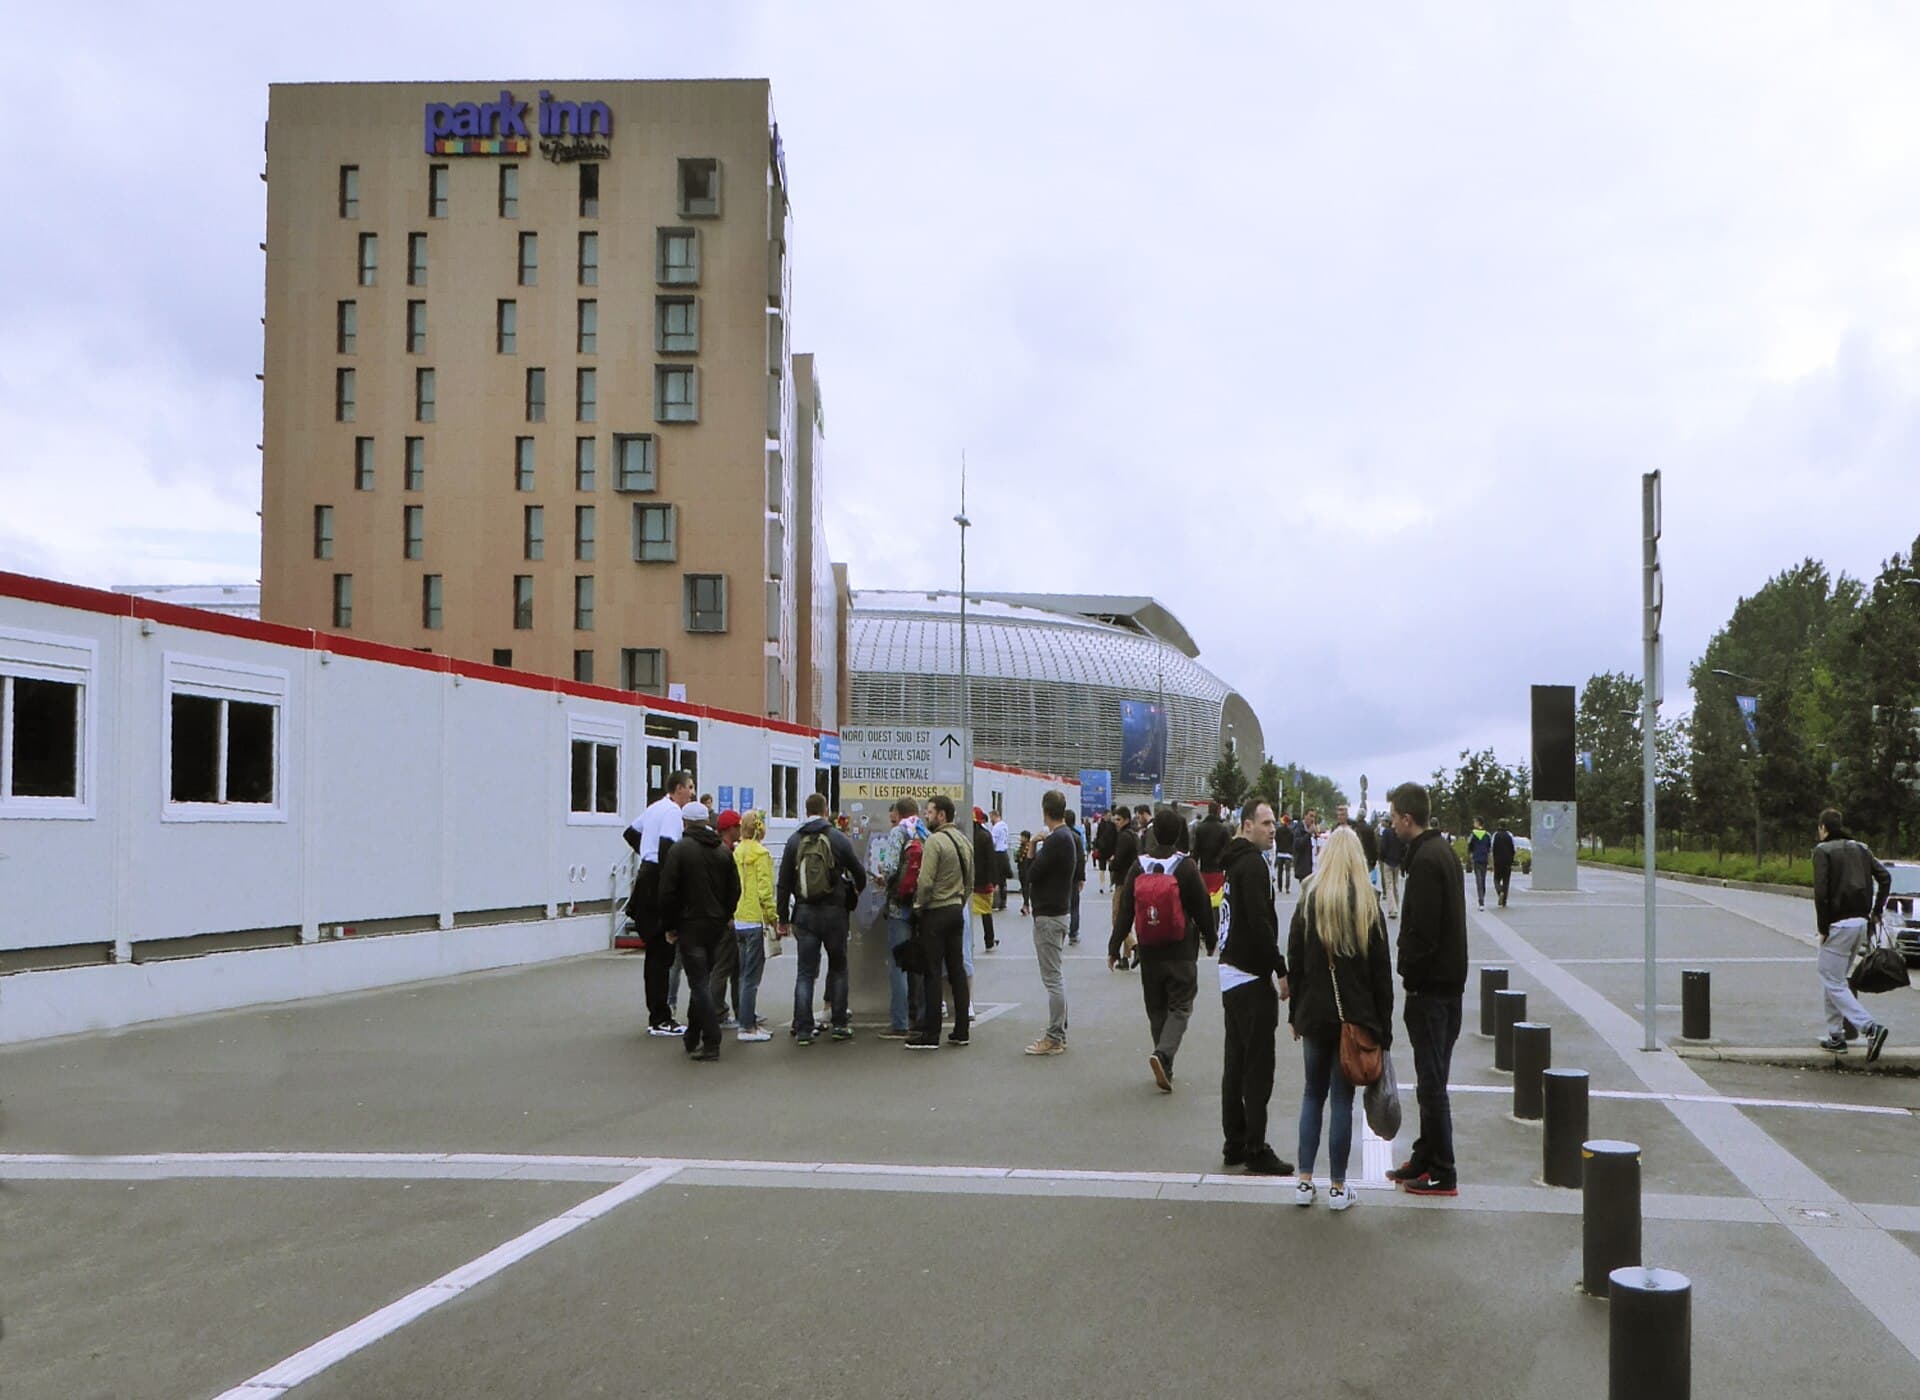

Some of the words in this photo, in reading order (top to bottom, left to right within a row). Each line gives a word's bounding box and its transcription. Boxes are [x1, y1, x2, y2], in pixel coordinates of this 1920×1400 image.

[425, 89, 530, 154] park
[539, 89, 612, 137] inn
[841, 730, 864, 742] NORD
[867, 730, 892, 743] OUEST
[896, 730, 912, 743] SUD
[916, 730, 931, 743] EST
[871, 749, 905, 761] ACCUEIL
[906, 749, 931, 761] STADE
[842, 767, 888, 779] BILLETTERIE
[889, 767, 929, 780] CENTRALE
[874, 785, 889, 797] LES
[891, 785, 938, 798] TERRASSES
